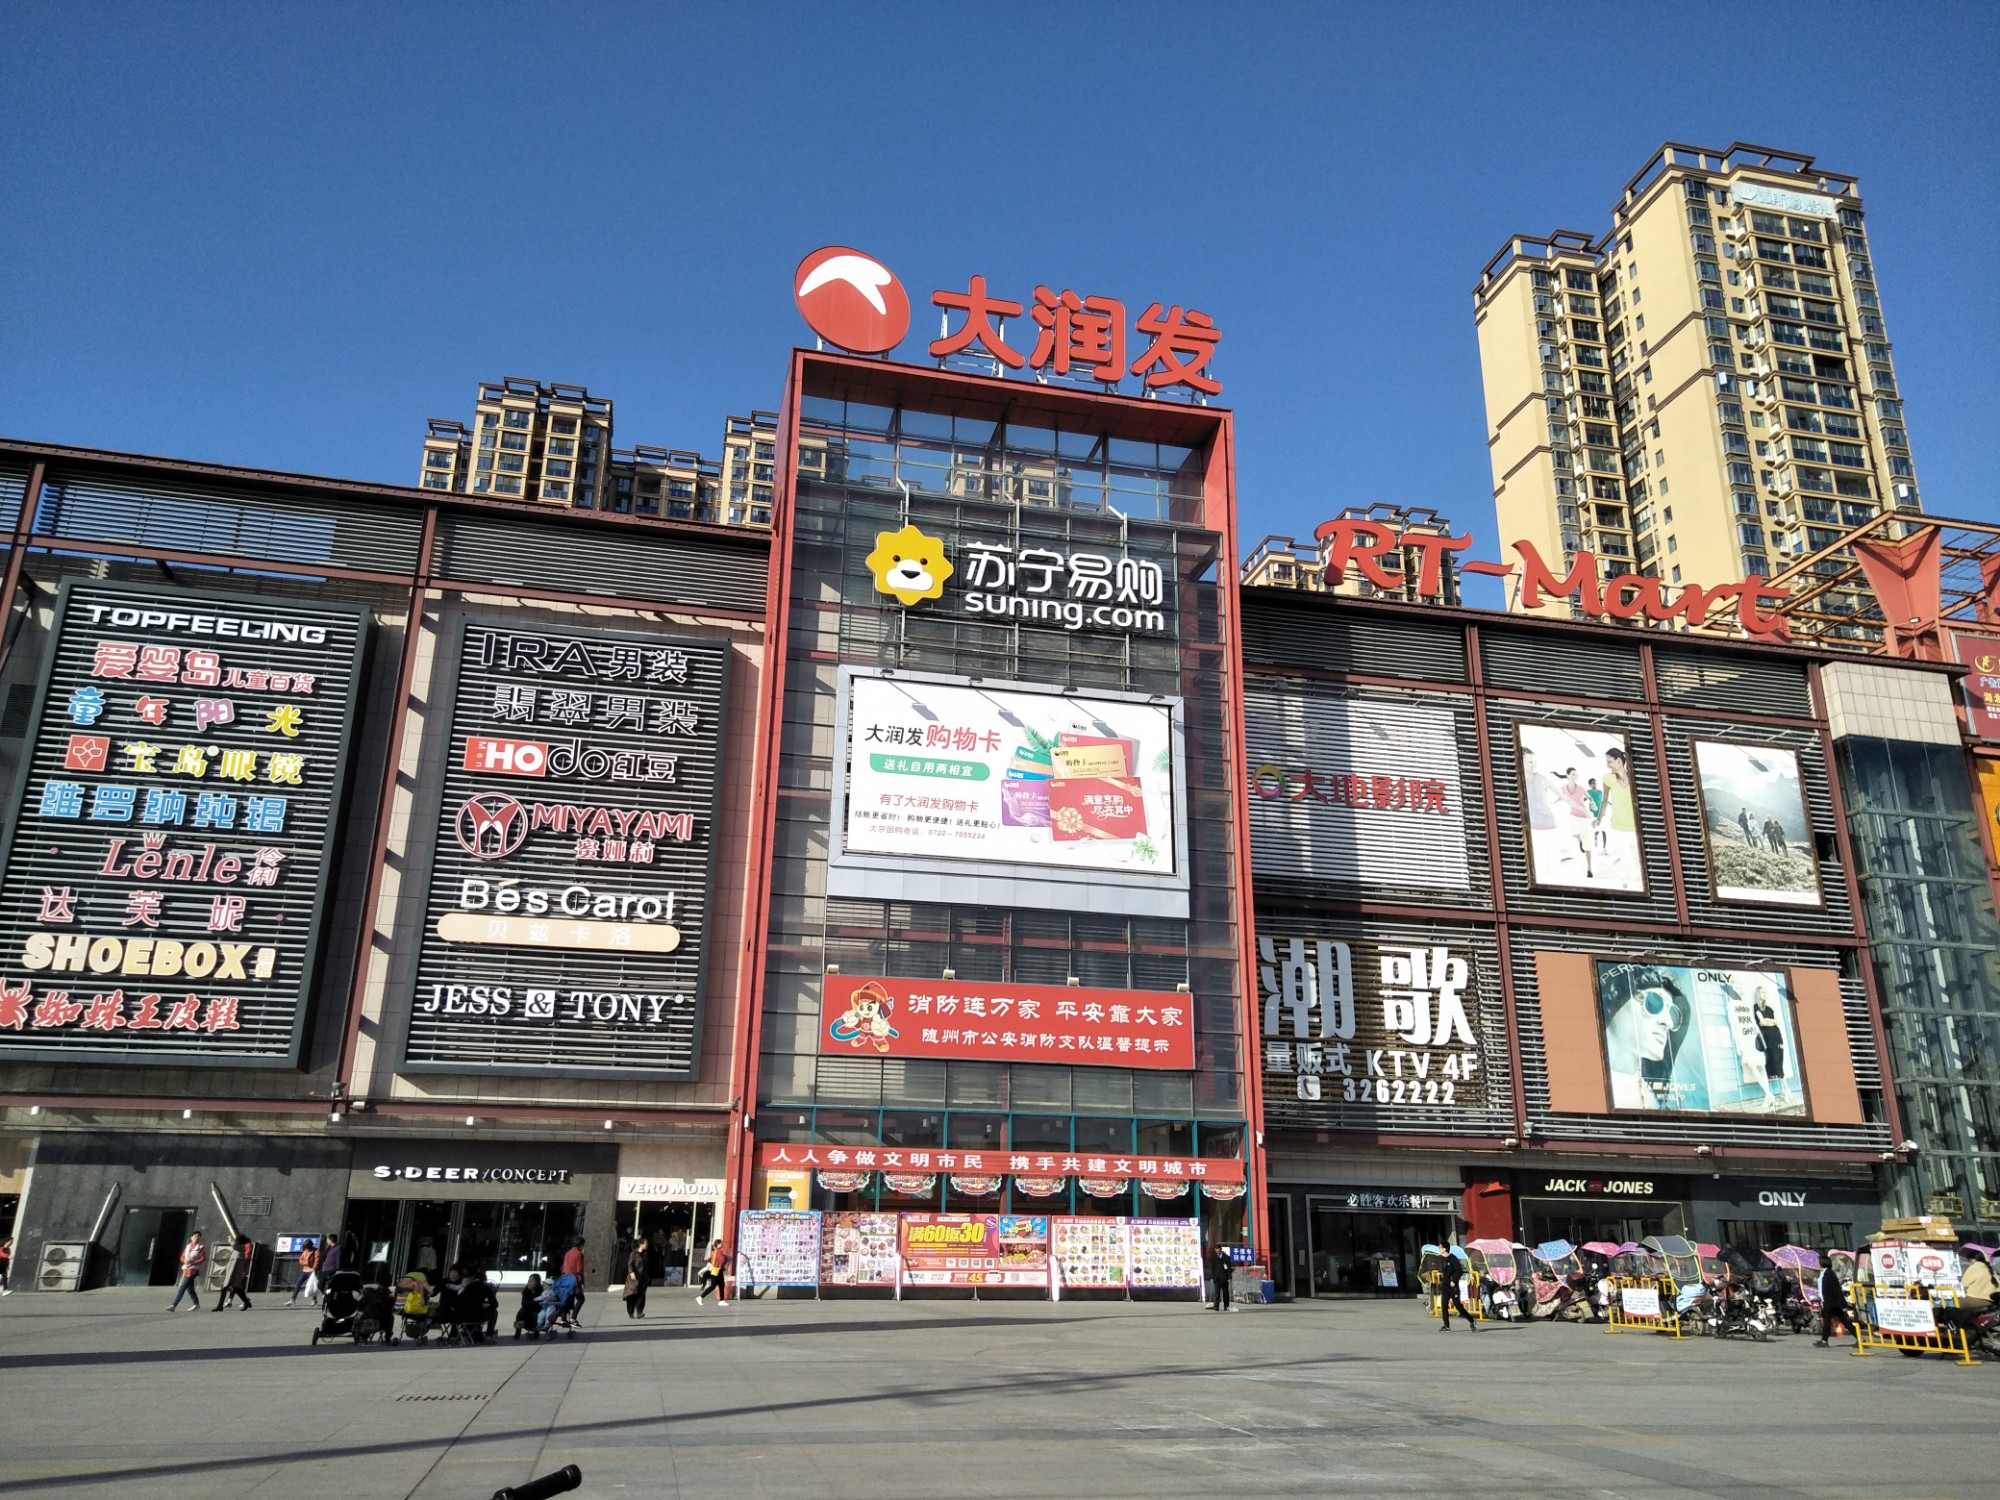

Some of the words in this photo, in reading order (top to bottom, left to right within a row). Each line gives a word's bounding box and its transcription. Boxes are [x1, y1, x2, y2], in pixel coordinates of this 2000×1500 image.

[928, 274, 1222, 396] 大润发
[964, 541, 1165, 606] 苏宁易购
[1313, 518, 1791, 636] RT-Mart
[87, 604, 326, 644] TOPFEELING
[964, 592, 1165, 631] suning.com
[92, 642, 221, 687] 爱婴岛
[222, 667, 315, 693] 儿童百货
[481, 632, 597, 676] IRA
[608, 645, 687, 684] 男装
[68, 686, 304, 737] 童年阳光
[493, 685, 700, 736] 翡翠男装
[864, 723, 1002, 753] 大润发购物卡
[124, 741, 304, 784] 宝岛眼镜
[611, 752, 678, 783] 红豆
[883, 758, 974, 777] 送礼自用两相宜
[39, 782, 289, 832] 维罗纳纯银
[879, 793, 979, 813] 有了大润发购物卡
[1289, 769, 1449, 814] 大地影院
[531, 803, 694, 840] MIYAYAMI
[99, 839, 241, 883] Lenle
[247, 847, 286, 886] 伶俐
[574, 838, 656, 864] 蜜娅莉
[37, 886, 246, 932] 达芙妮
[560, 885, 675, 920] Carol
[486, 919, 632, 946] 贝兹卡洛
[22, 932, 254, 979] SHOEBOX
[1258, 936, 1478, 1046] 潮歌
[1697, 971, 1732, 984] ONLY
[32, 989, 240, 1032] 蜘蛛王皮鞋
[424, 984, 512, 1014] JESS
[527, 990, 555, 1017] &
[570, 991, 669, 1023] TONY
[908, 993, 1042, 1020] 消防连万家
[1055, 1000, 1184, 1027] 平安靠大家
[922, 1028, 1170, 1053] 随州市公安消防支队温馨提示
[1265, 1041, 1352, 1076] 量贩式
[1366, 1049, 1430, 1078] KTV
[1443, 1052, 1478, 1080] 4F
[1343, 1078, 1456, 1105] 3262222
[771, 1150, 983, 1168] 人人争做文明市民
[1009, 1156, 1208, 1176] 携手共建文明城市
[625, 1182, 668, 1194] VERO
[671, 1183, 718, 1195] MODA
[1347, 1193, 1432, 1209] 必胜客欢乐餐厅
[1545, 1178, 1587, 1192] JACK
[1603, 1180, 1654, 1194] JONES
[1758, 1191, 1807, 1207] ONLY
[968, 1273, 983, 1283] 45
